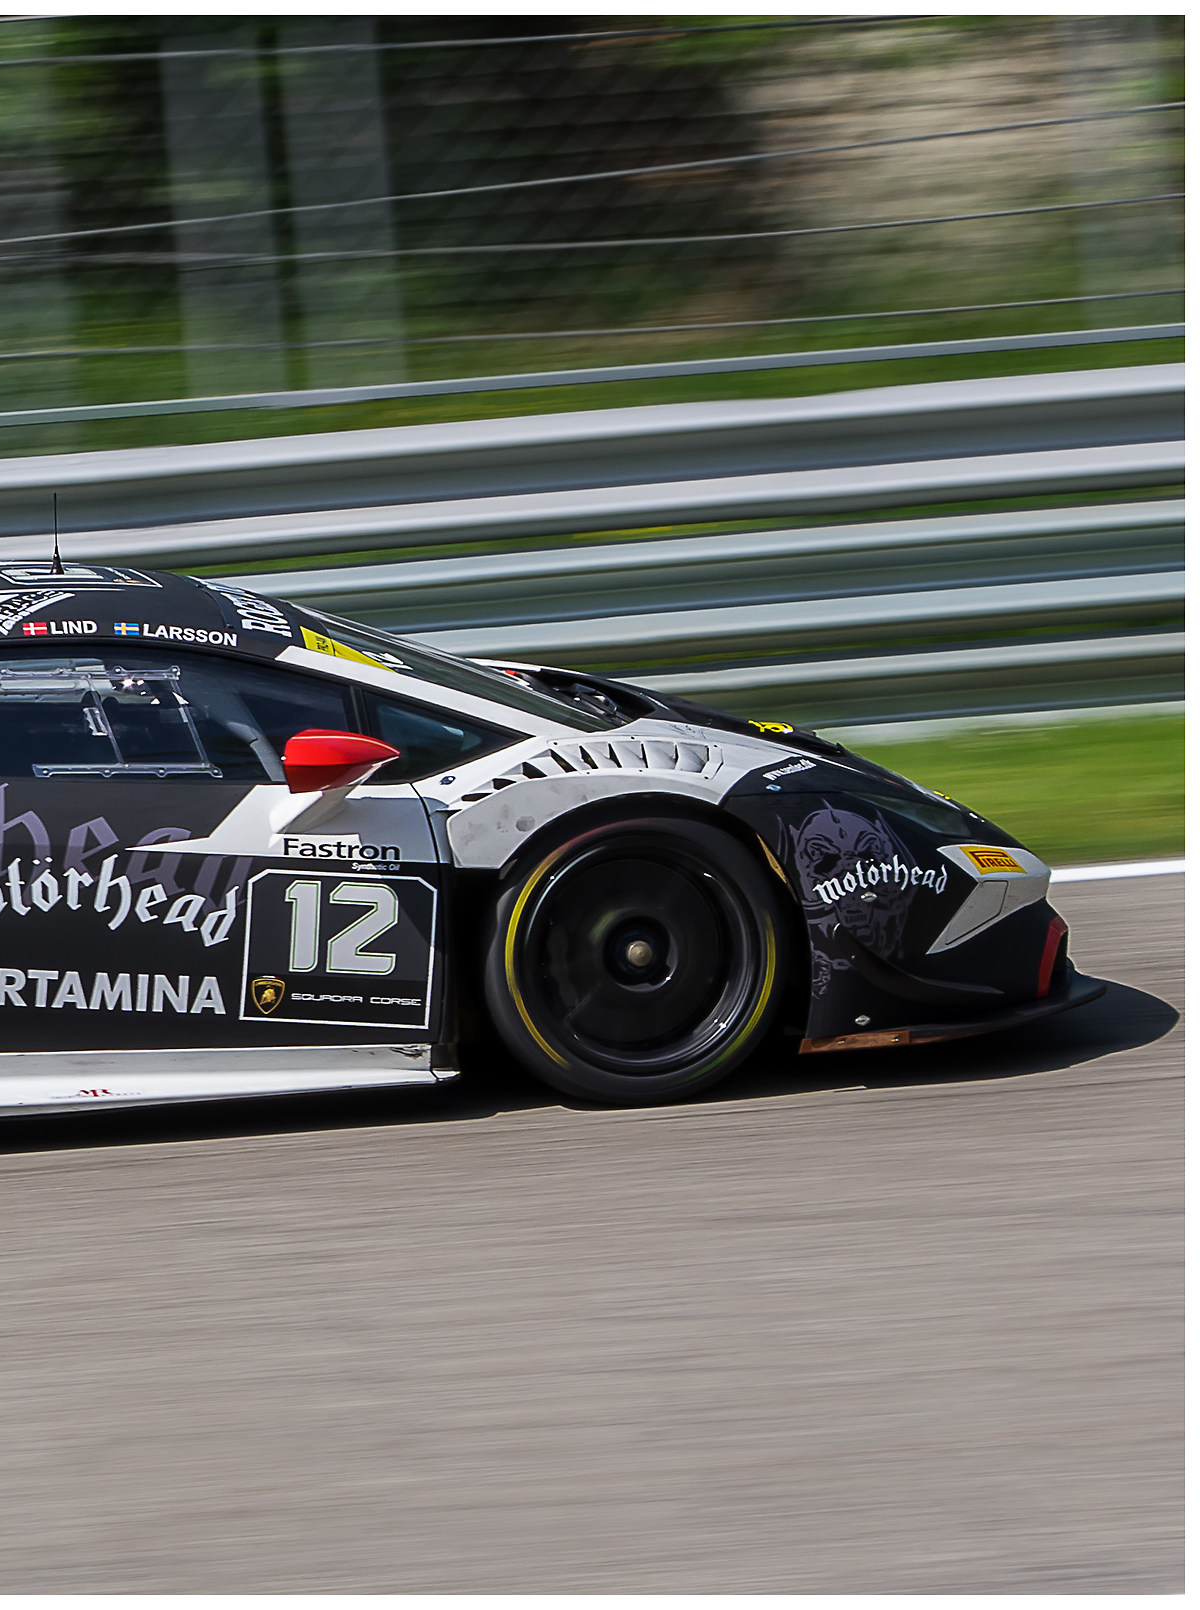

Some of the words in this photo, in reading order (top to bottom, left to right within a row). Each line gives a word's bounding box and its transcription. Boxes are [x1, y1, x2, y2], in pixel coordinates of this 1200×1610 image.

[50, 621, 98, 635] LIND
[143, 623, 237, 647] LARSSON
[283, 838, 400, 861] Fastron
[969, 850, 1019, 868] PIRELLI
[813, 854, 948, 904] motörhead
[285, 880, 399, 976] 12
[291, 993, 363, 1003] SQUADRA
[370, 997, 422, 1006] CORSE
